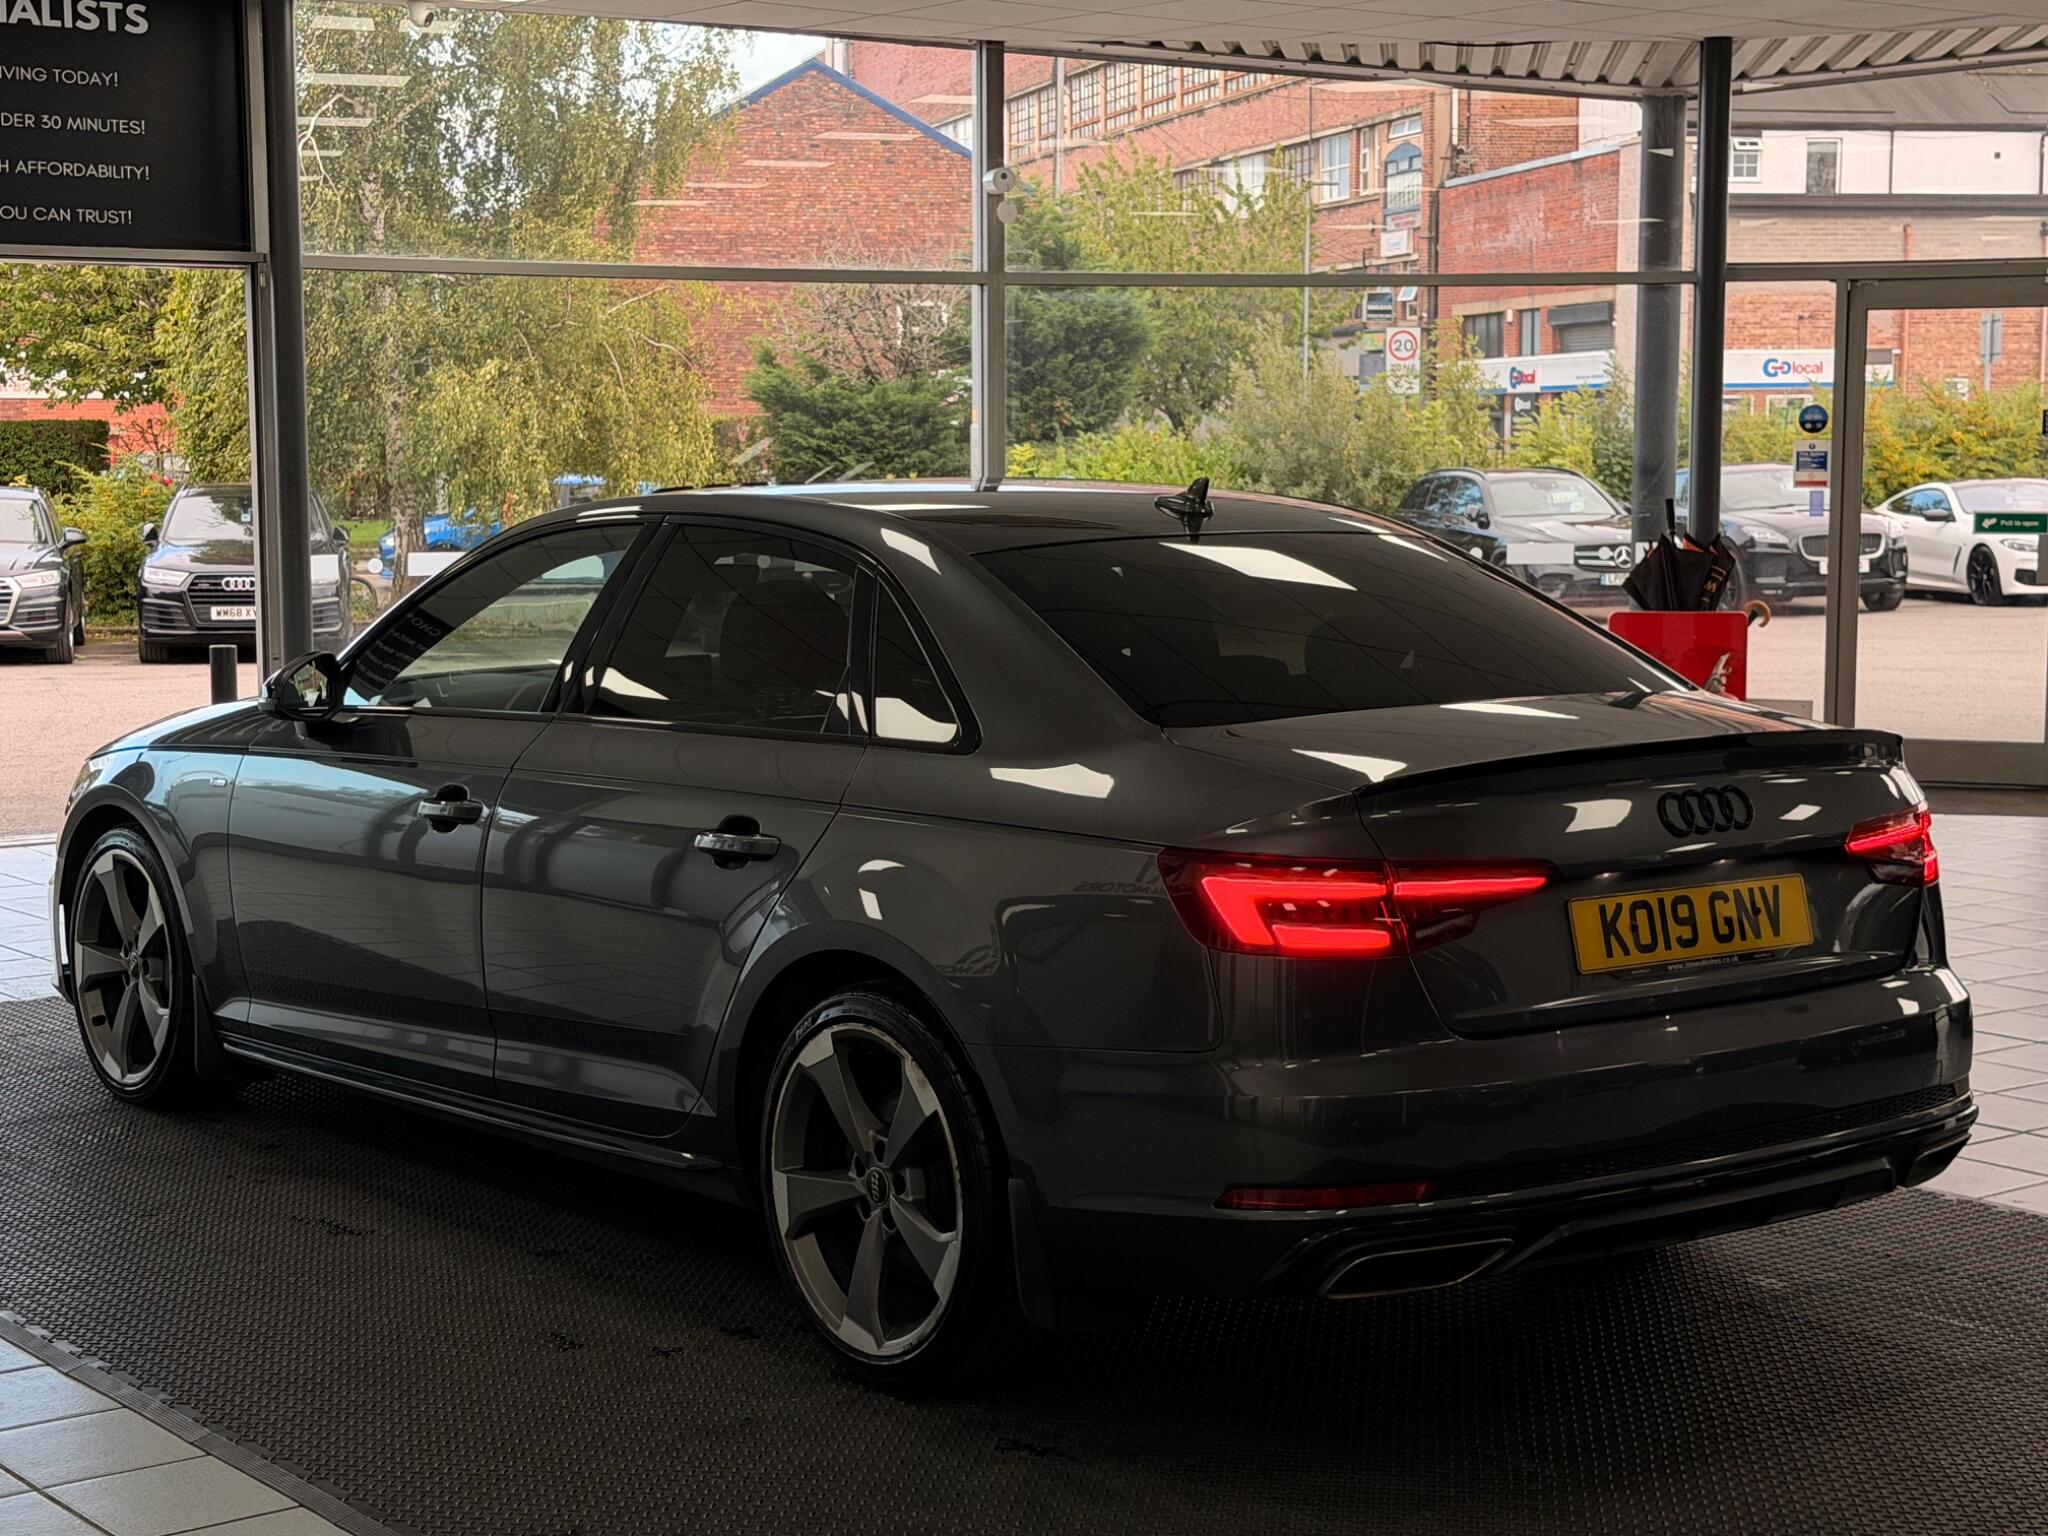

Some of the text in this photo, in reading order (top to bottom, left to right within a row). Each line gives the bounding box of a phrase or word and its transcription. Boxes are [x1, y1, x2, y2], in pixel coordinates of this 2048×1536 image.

[53, 69, 119, 87] TODAY!
[1, 113, 146, 135] DER 30 MINUTES!
[15, 160, 150, 181] AFFORDABILITY!
[0, 205, 133, 225] OU CAN TRUST!
[1394, 339, 1414, 352] 20
[1598, 884, 1780, 959] KO19 GNV
